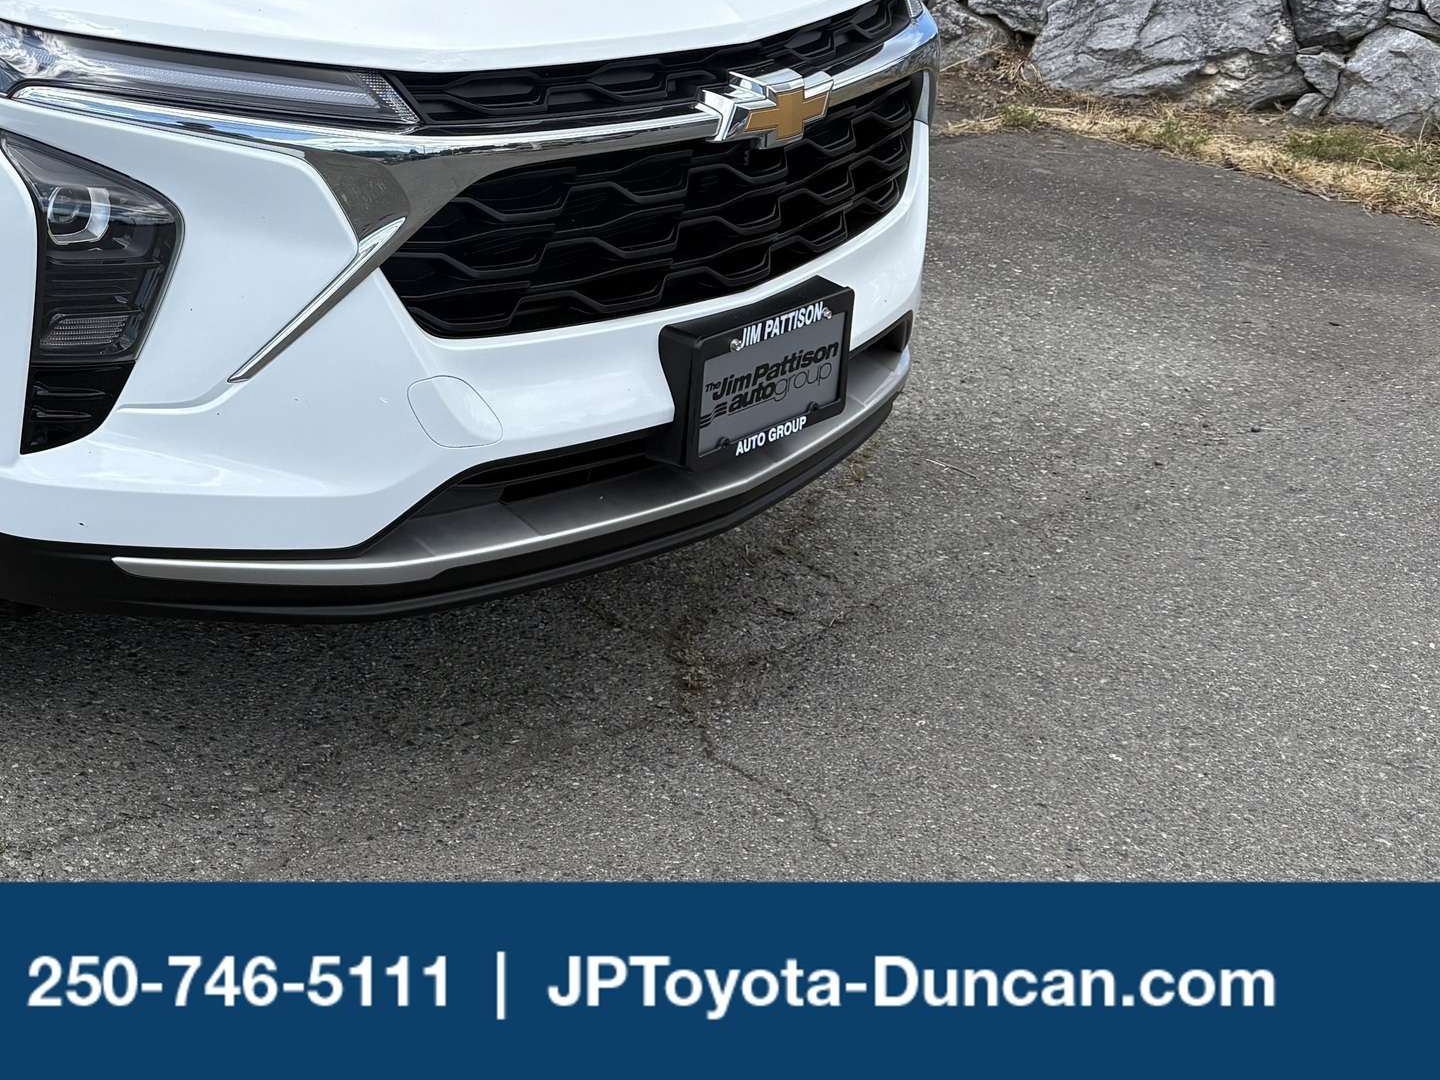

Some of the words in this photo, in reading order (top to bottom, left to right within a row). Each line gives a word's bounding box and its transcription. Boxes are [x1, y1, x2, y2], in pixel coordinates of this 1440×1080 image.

[739, 322, 763, 349] JIM
[764, 301, 824, 340] PATTISON
[752, 341, 840, 386] Pattison
[735, 432, 766, 456] AUTO
[768, 416, 808, 442] GROUP
